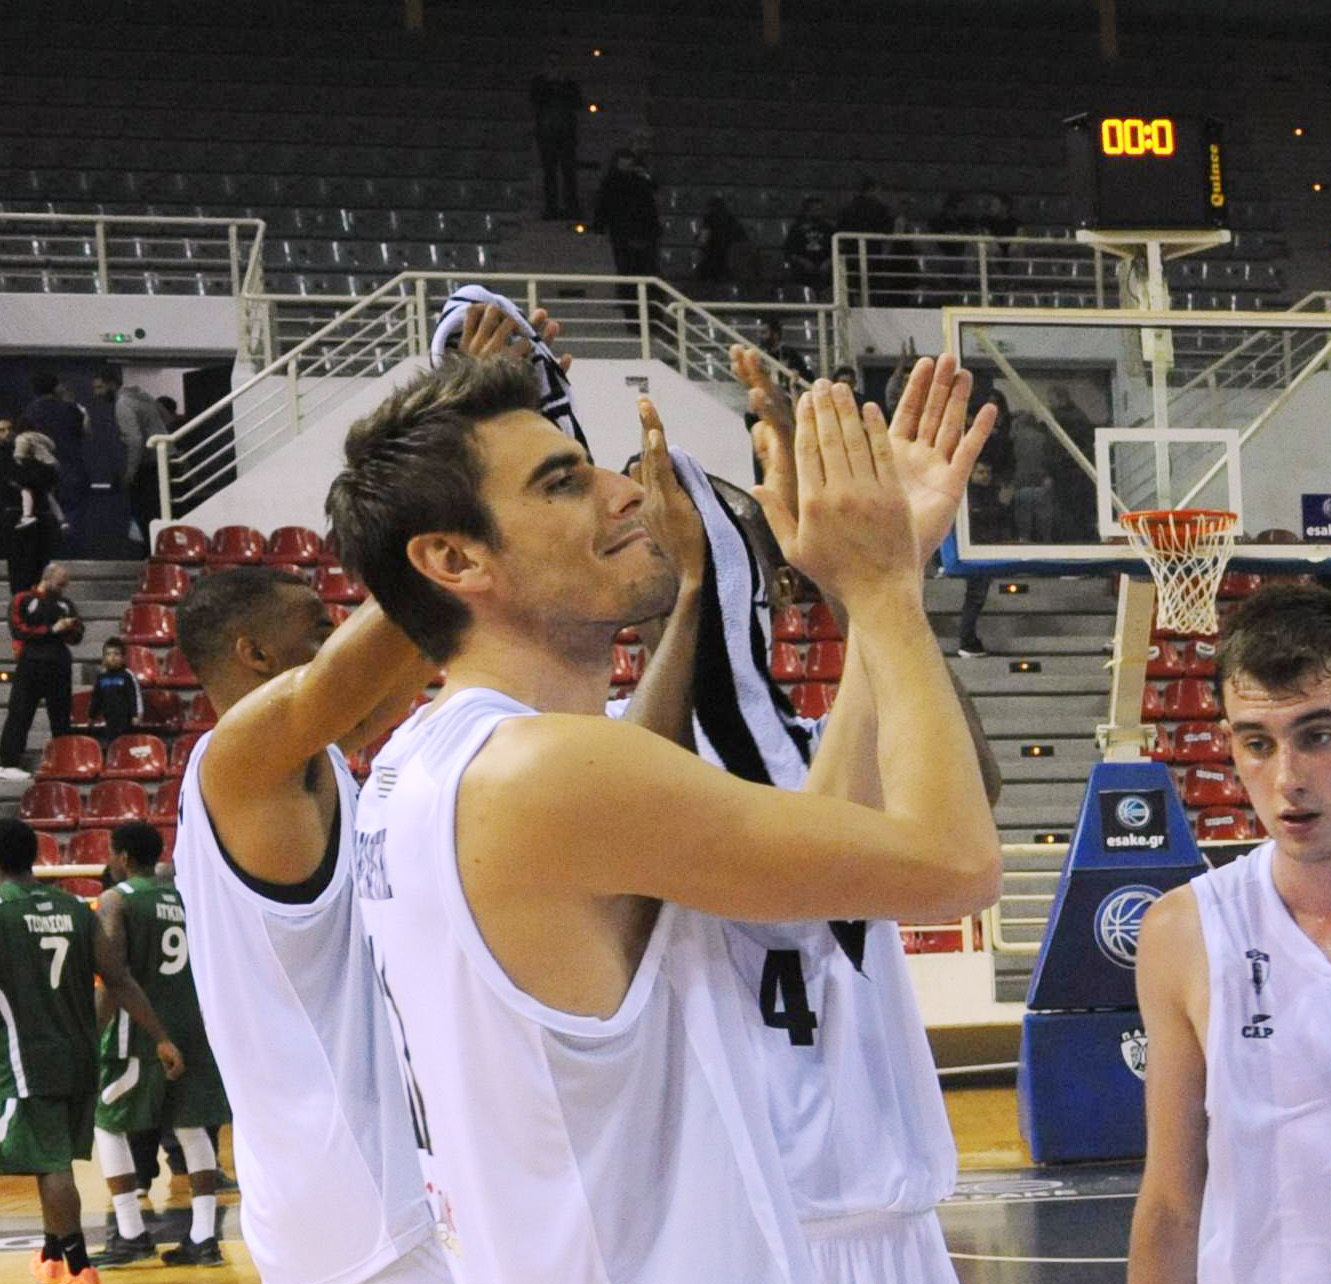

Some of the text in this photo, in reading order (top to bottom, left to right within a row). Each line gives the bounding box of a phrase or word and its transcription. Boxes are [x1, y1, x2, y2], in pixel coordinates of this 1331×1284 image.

[1101, 118, 1174, 155] 00:0
[1106, 833, 1165, 849] esake.gr
[39, 935, 70, 990] 7
[159, 926, 188, 975] 9
[759, 949, 818, 1046] 4
[1241, 1025, 1274, 1039] CAP
